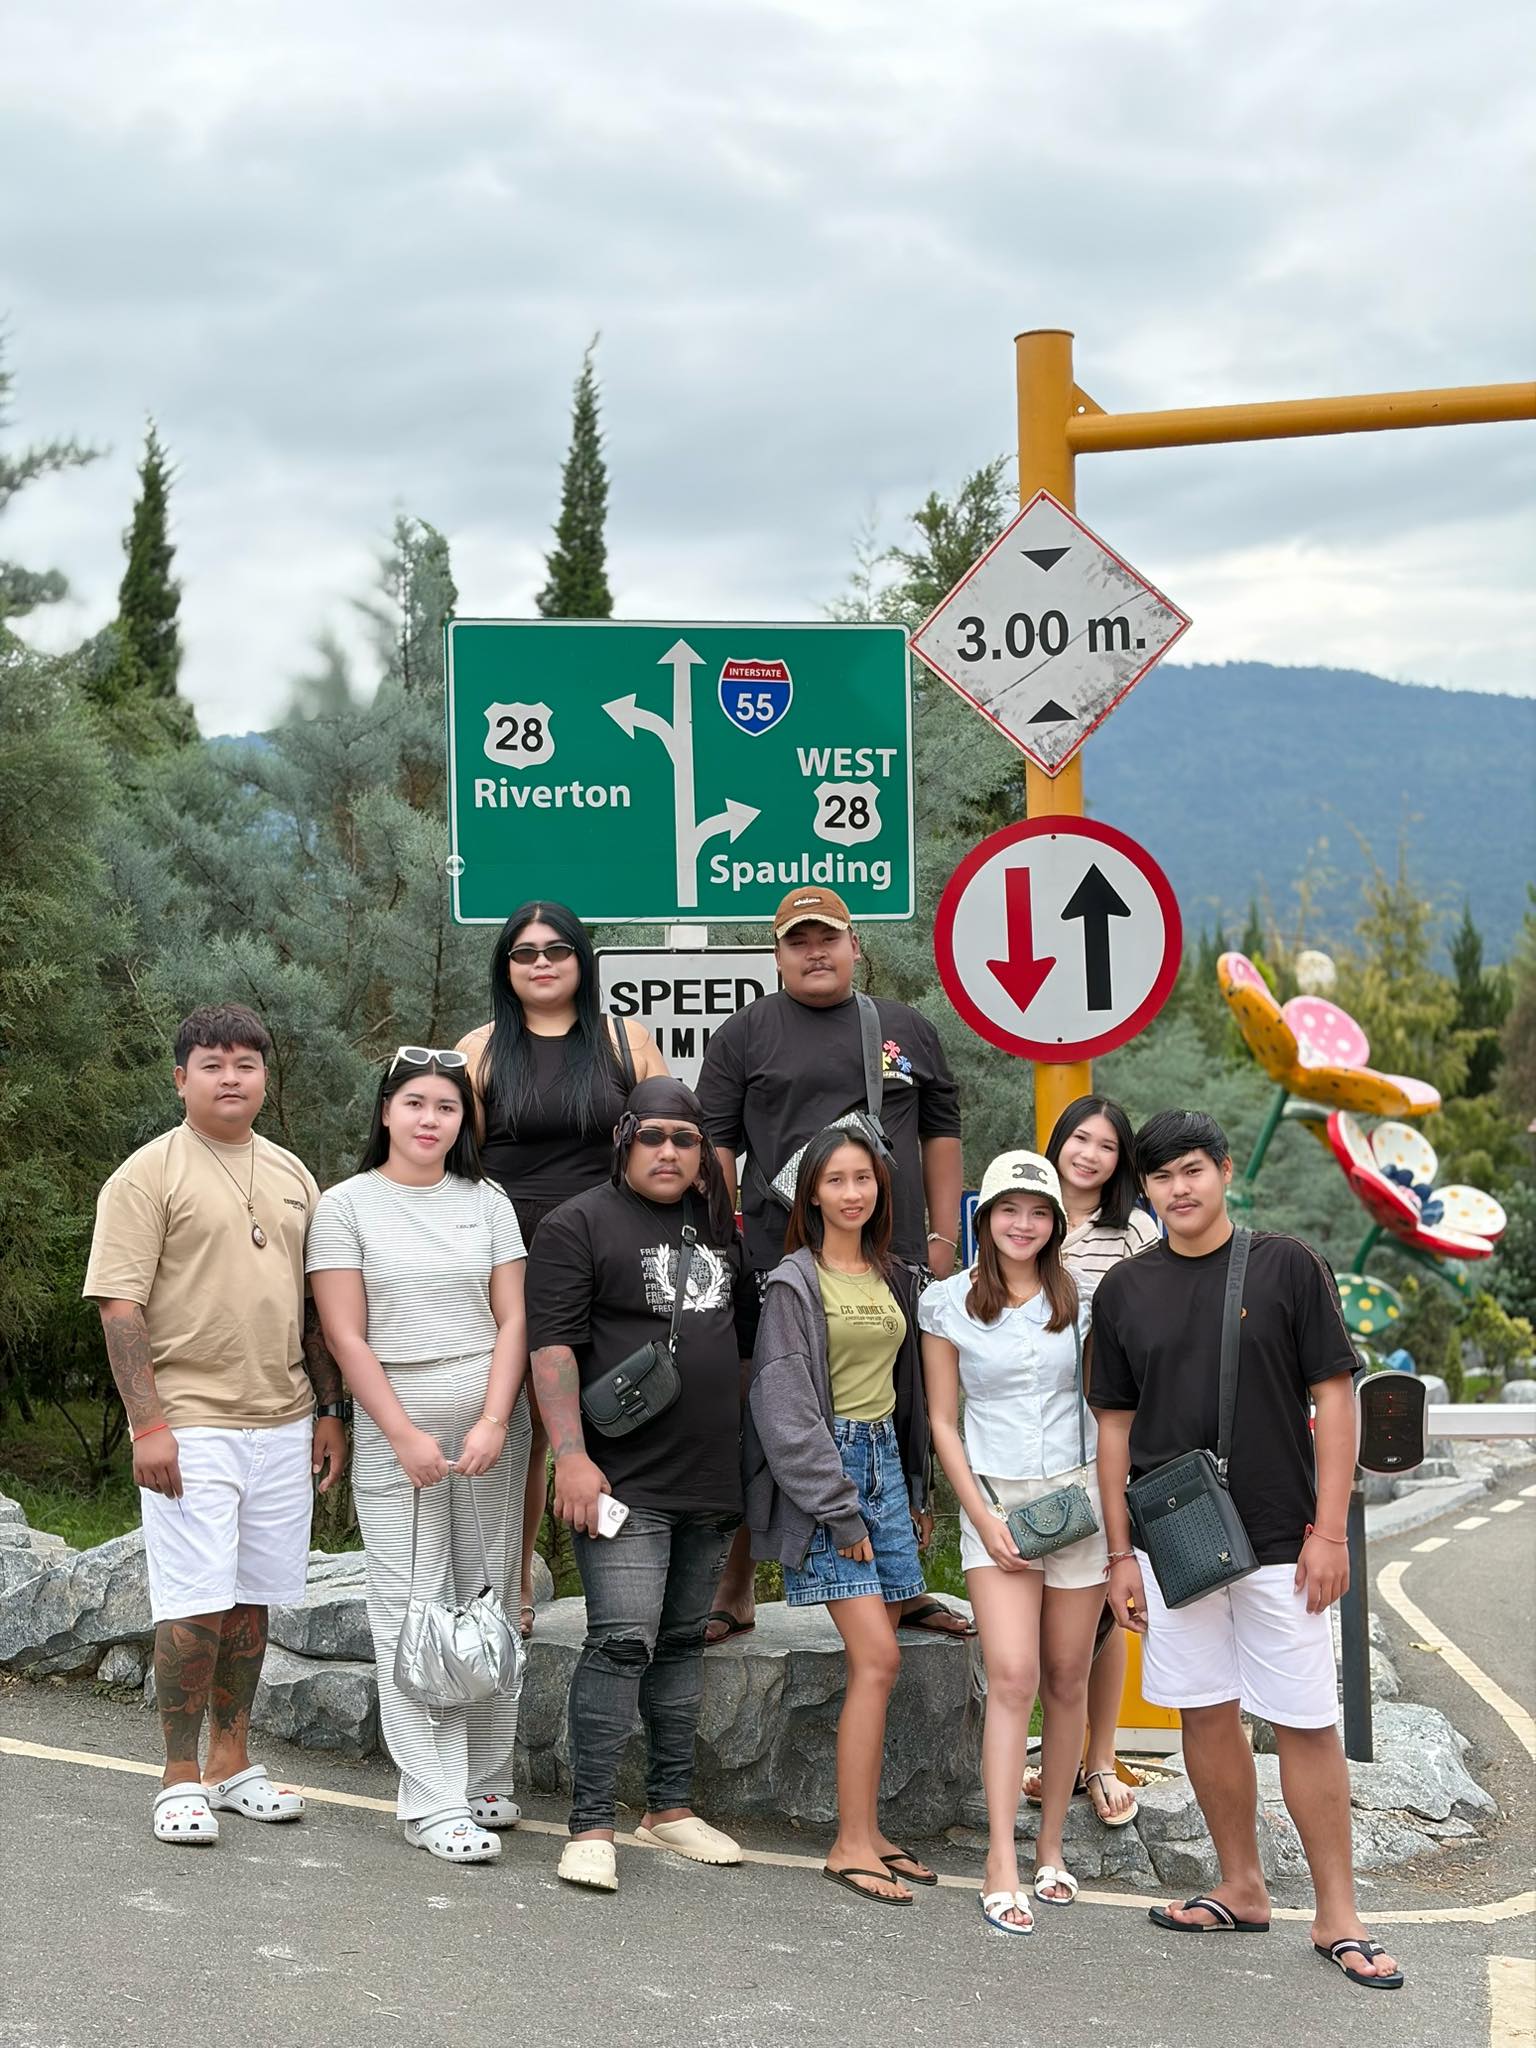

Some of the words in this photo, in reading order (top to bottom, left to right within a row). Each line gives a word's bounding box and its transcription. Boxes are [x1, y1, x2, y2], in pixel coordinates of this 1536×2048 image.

[957, 610, 1069, 662] 3.00
[1087, 616, 1146, 652] m.
[729, 667, 783, 679] INTERSTATE
[735, 693, 776, 722] 55
[494, 716, 545, 752] 28
[797, 748, 898, 777] WEST
[474, 778, 631, 809] Riverton
[823, 795, 870, 829] 28
[709, 854, 893, 891] Spaulding
[609, 978, 765, 1017] SPEED
[656, 1027, 711, 1058] IMI
